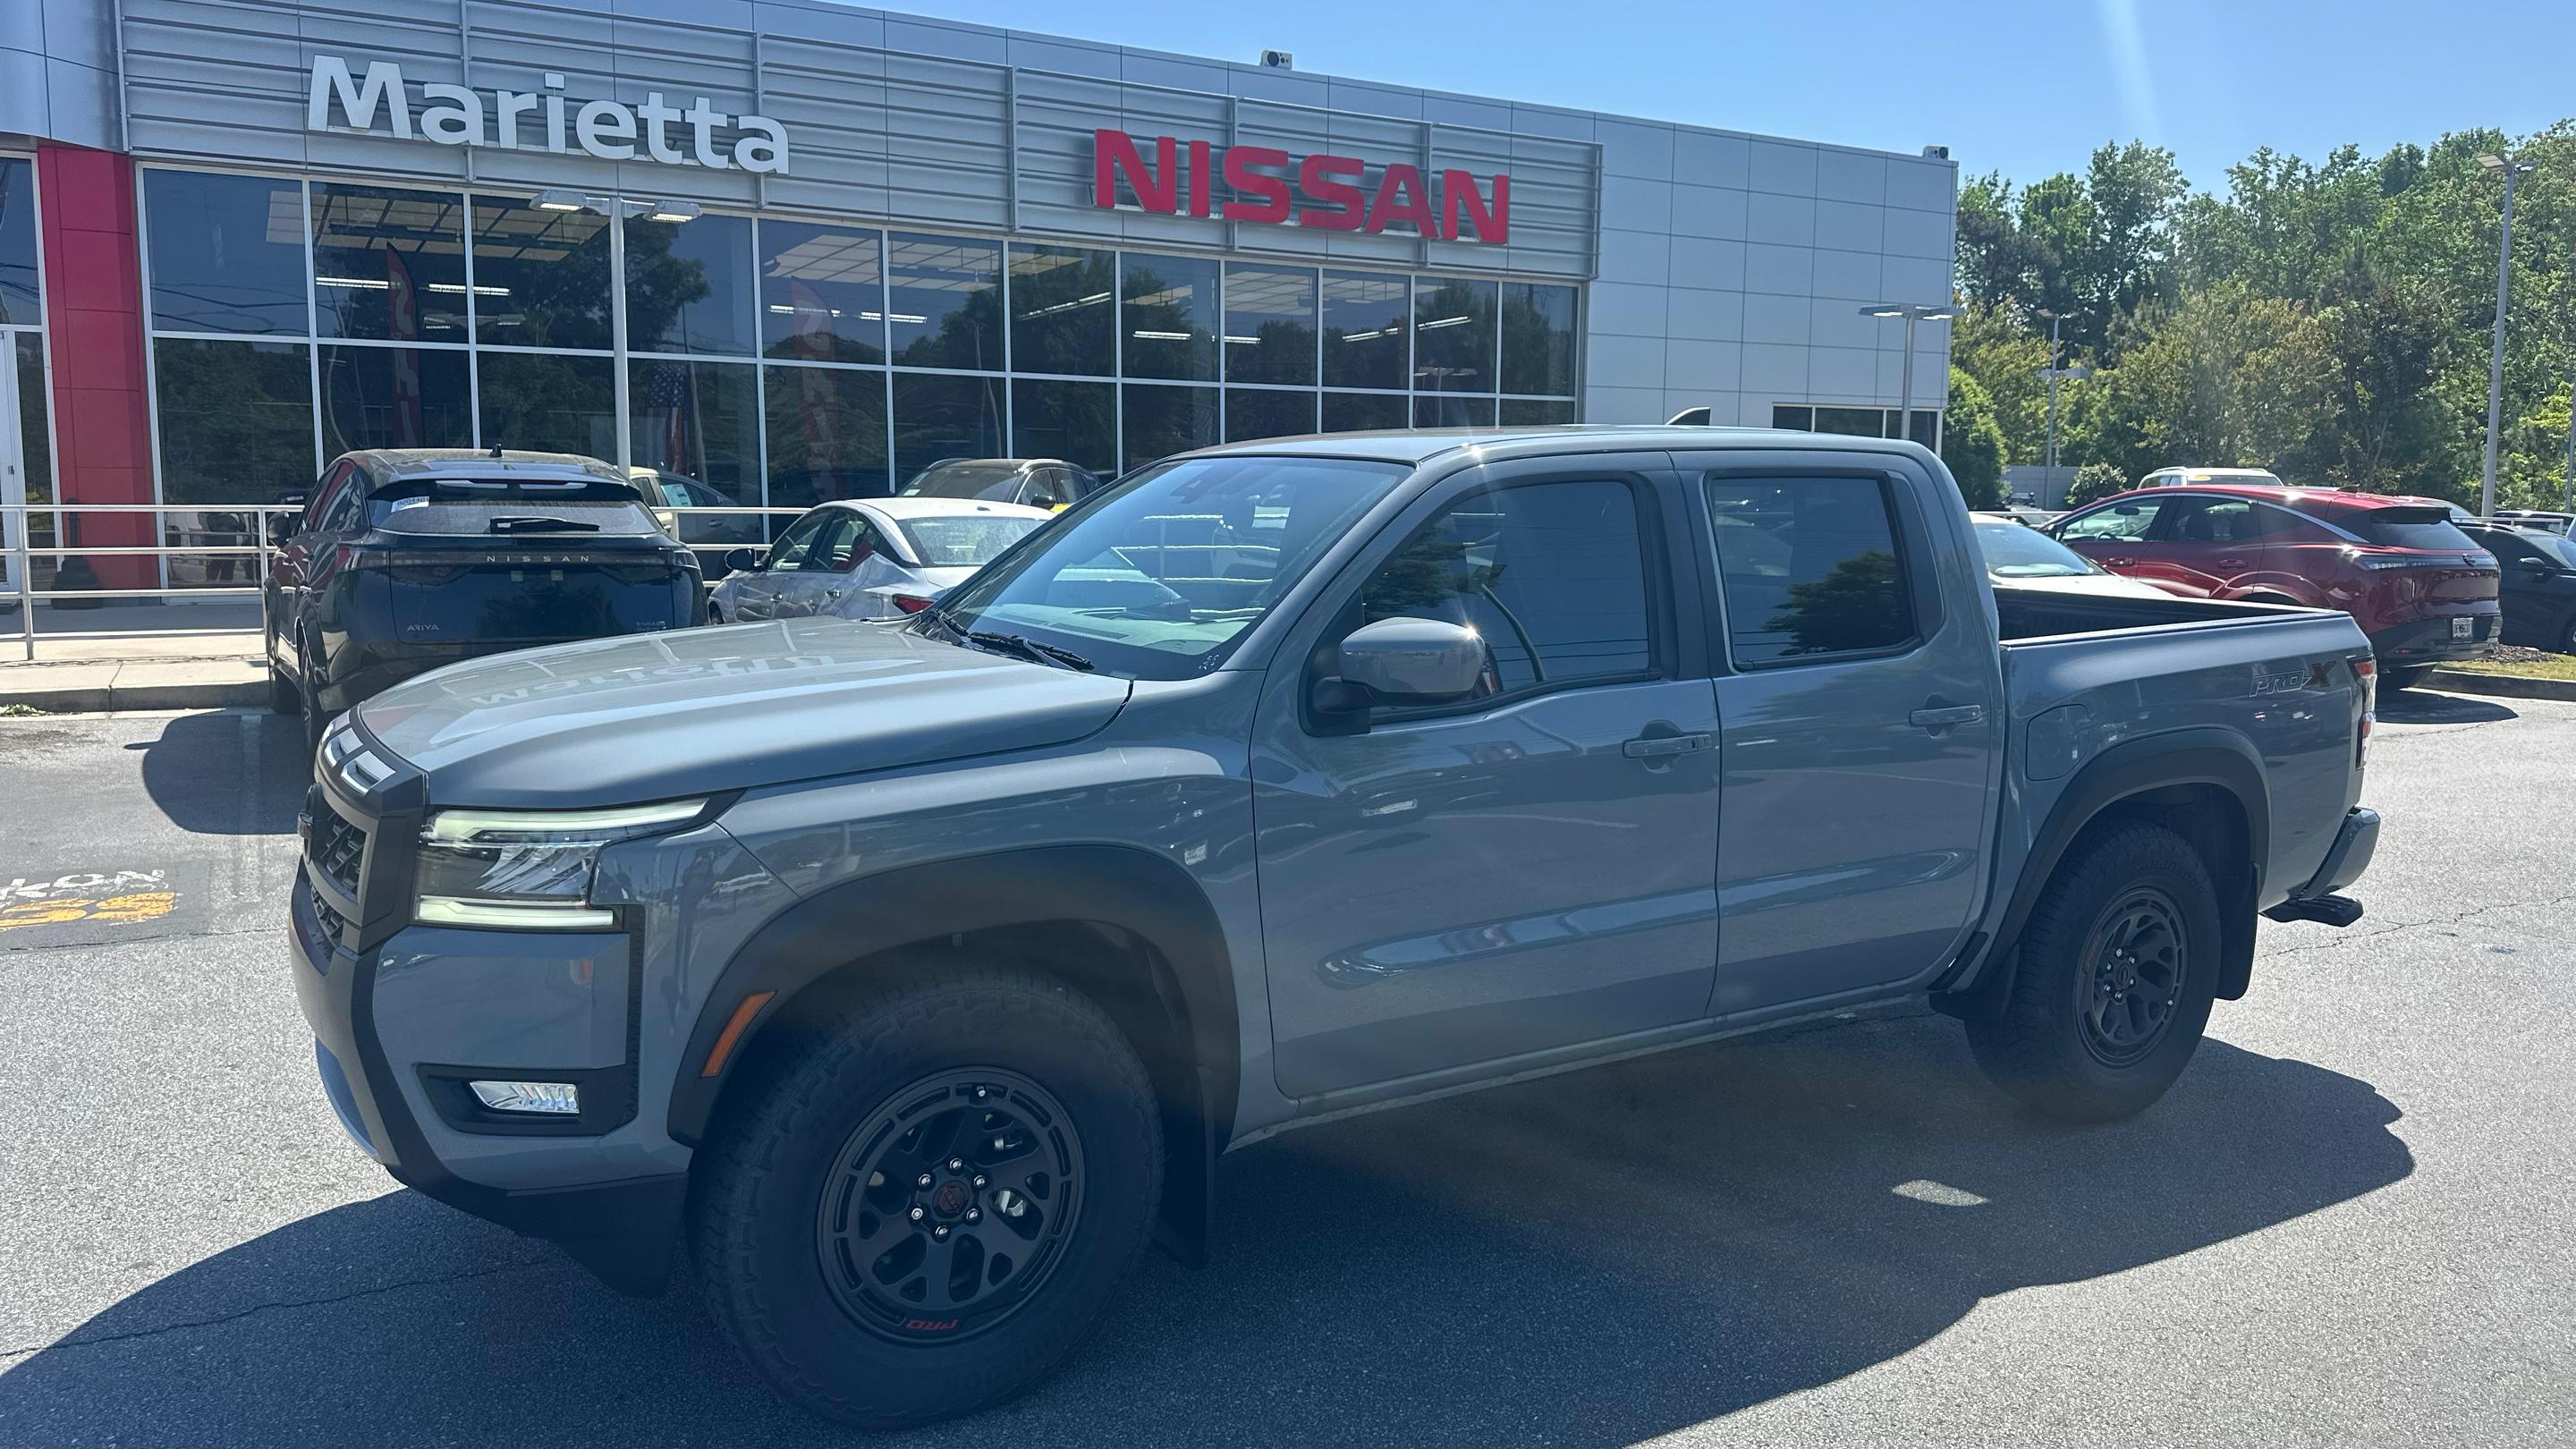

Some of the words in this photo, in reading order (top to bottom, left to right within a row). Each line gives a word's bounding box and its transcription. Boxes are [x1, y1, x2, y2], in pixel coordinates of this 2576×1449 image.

[307, 54, 790, 174] Marietta
[1093, 128, 1510, 245] NISSAN
[486, 555, 589, 564] NISSAN
[406, 623, 440, 631] ARIYA
